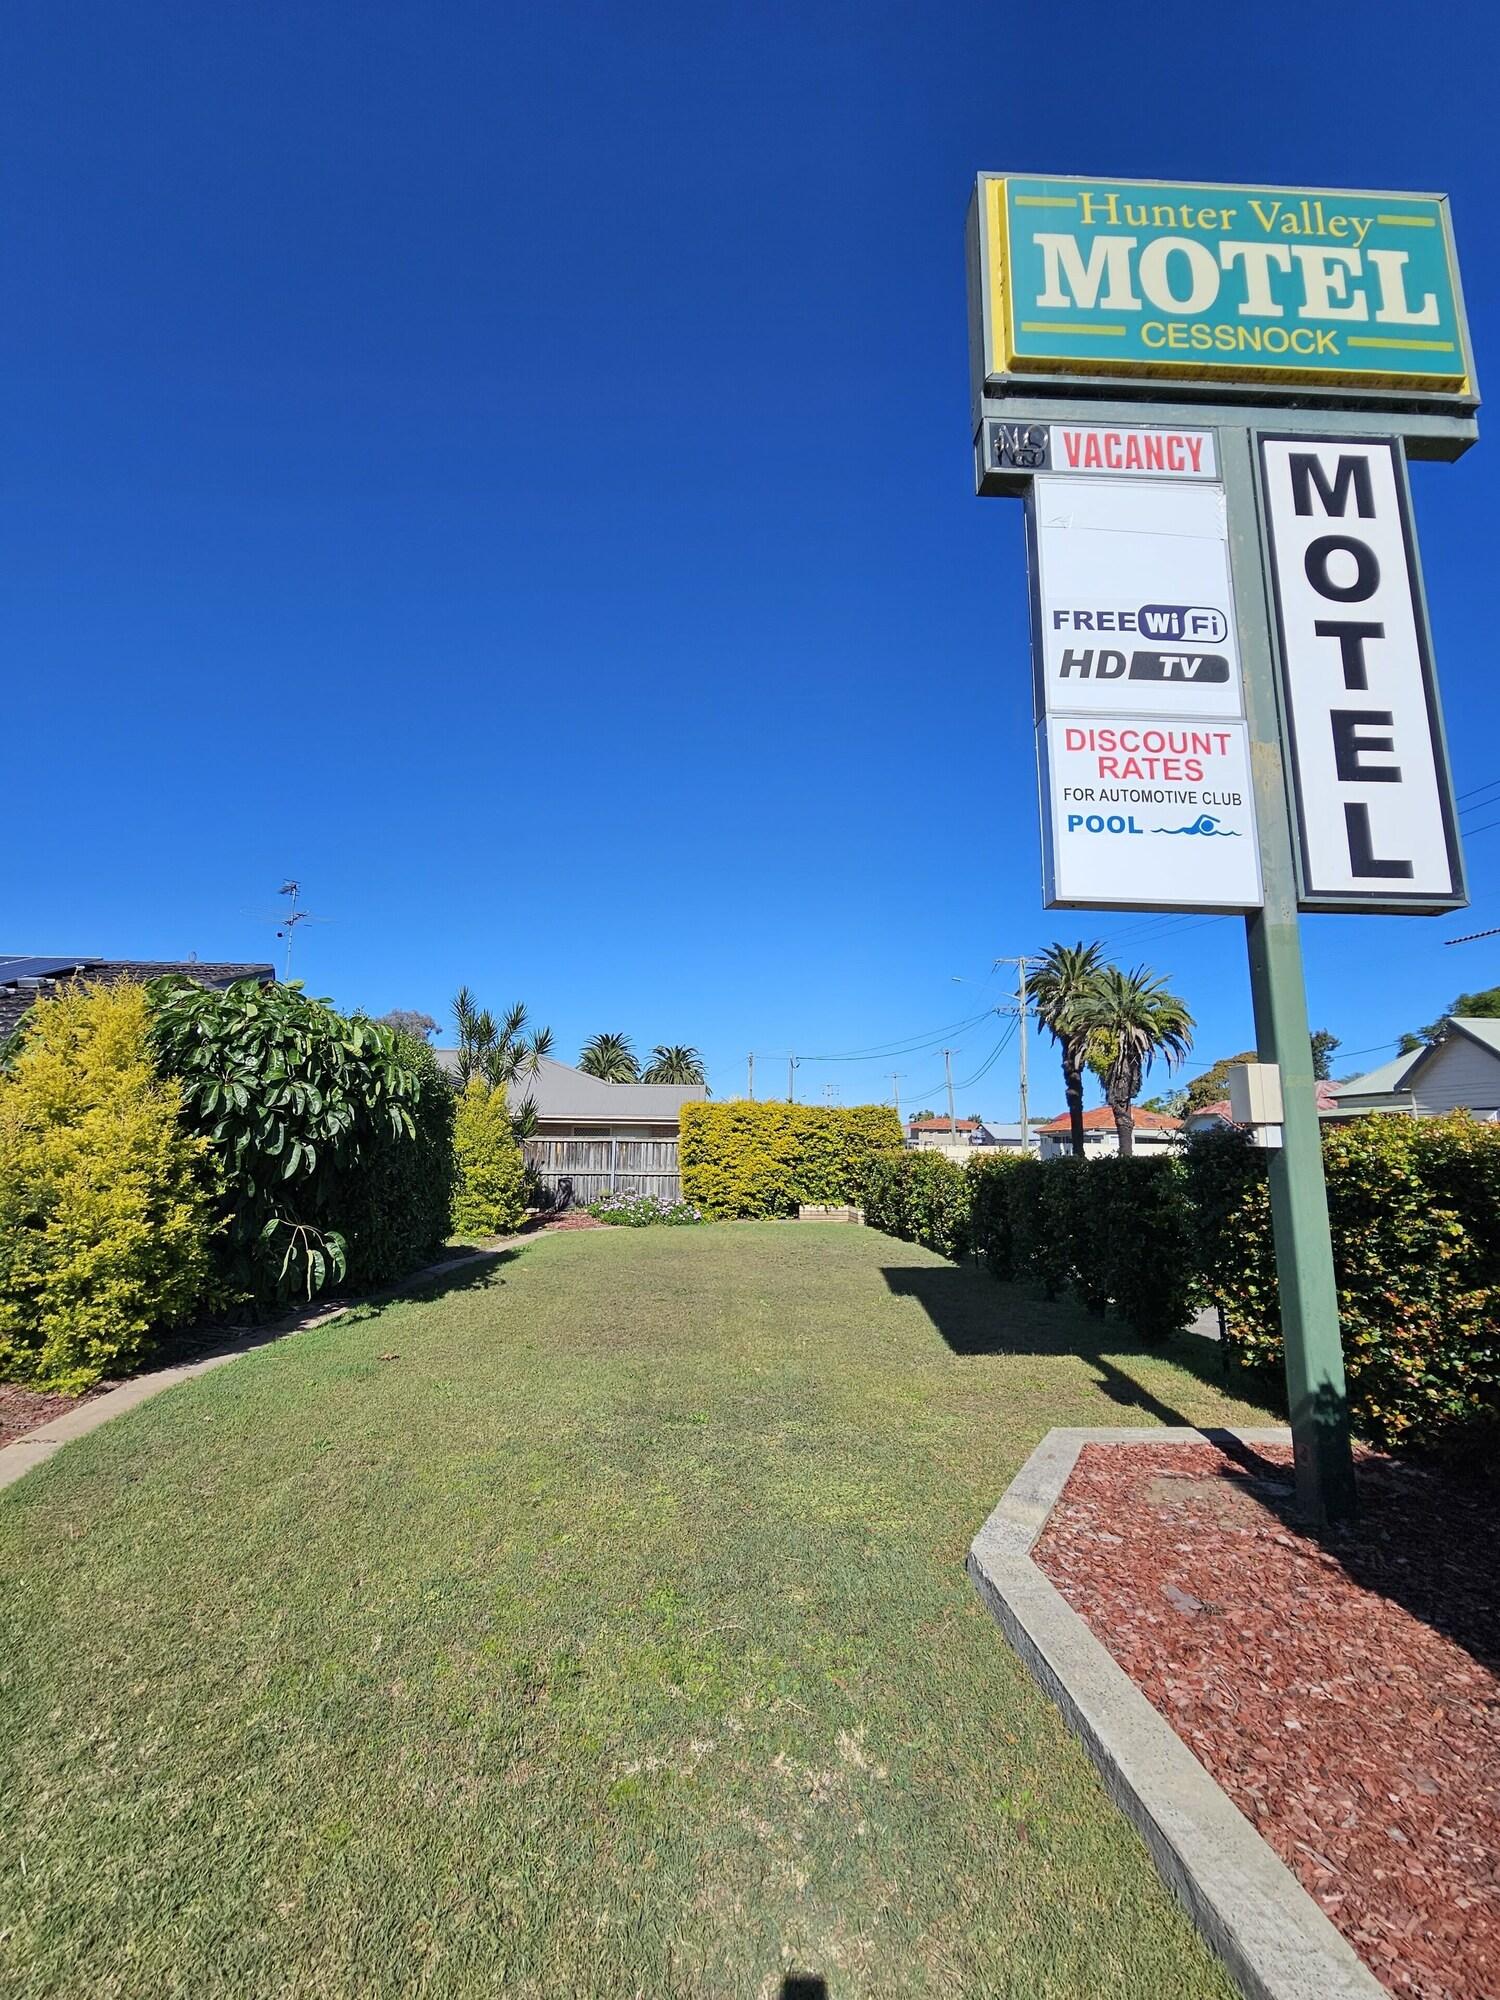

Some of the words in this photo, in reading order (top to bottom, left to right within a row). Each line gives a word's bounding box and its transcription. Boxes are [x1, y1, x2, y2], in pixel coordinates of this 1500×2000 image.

[1079, 192, 1236, 230] Hunter
[1248, 200, 1374, 247] Valley
[1033, 233, 1440, 326] MOTEL
[1141, 321, 1339, 355] CESSNOCK
[1063, 432, 1203, 472] VACANCY
[1053, 610, 1137, 632] FREE
[1059, 649, 1127, 679] HD
[1159, 656, 1202, 678] TV
[1288, 452, 1414, 879] MOTEL
[1065, 728, 1231, 755] DISCOUNT
[1098, 756, 1204, 782] RATES
[1064, 788, 1095, 801] FOR
[1099, 789, 1197, 804] AUTOMOTIVE
[1202, 792, 1242, 806] CLUB
[1068, 814, 1143, 834] POOL
